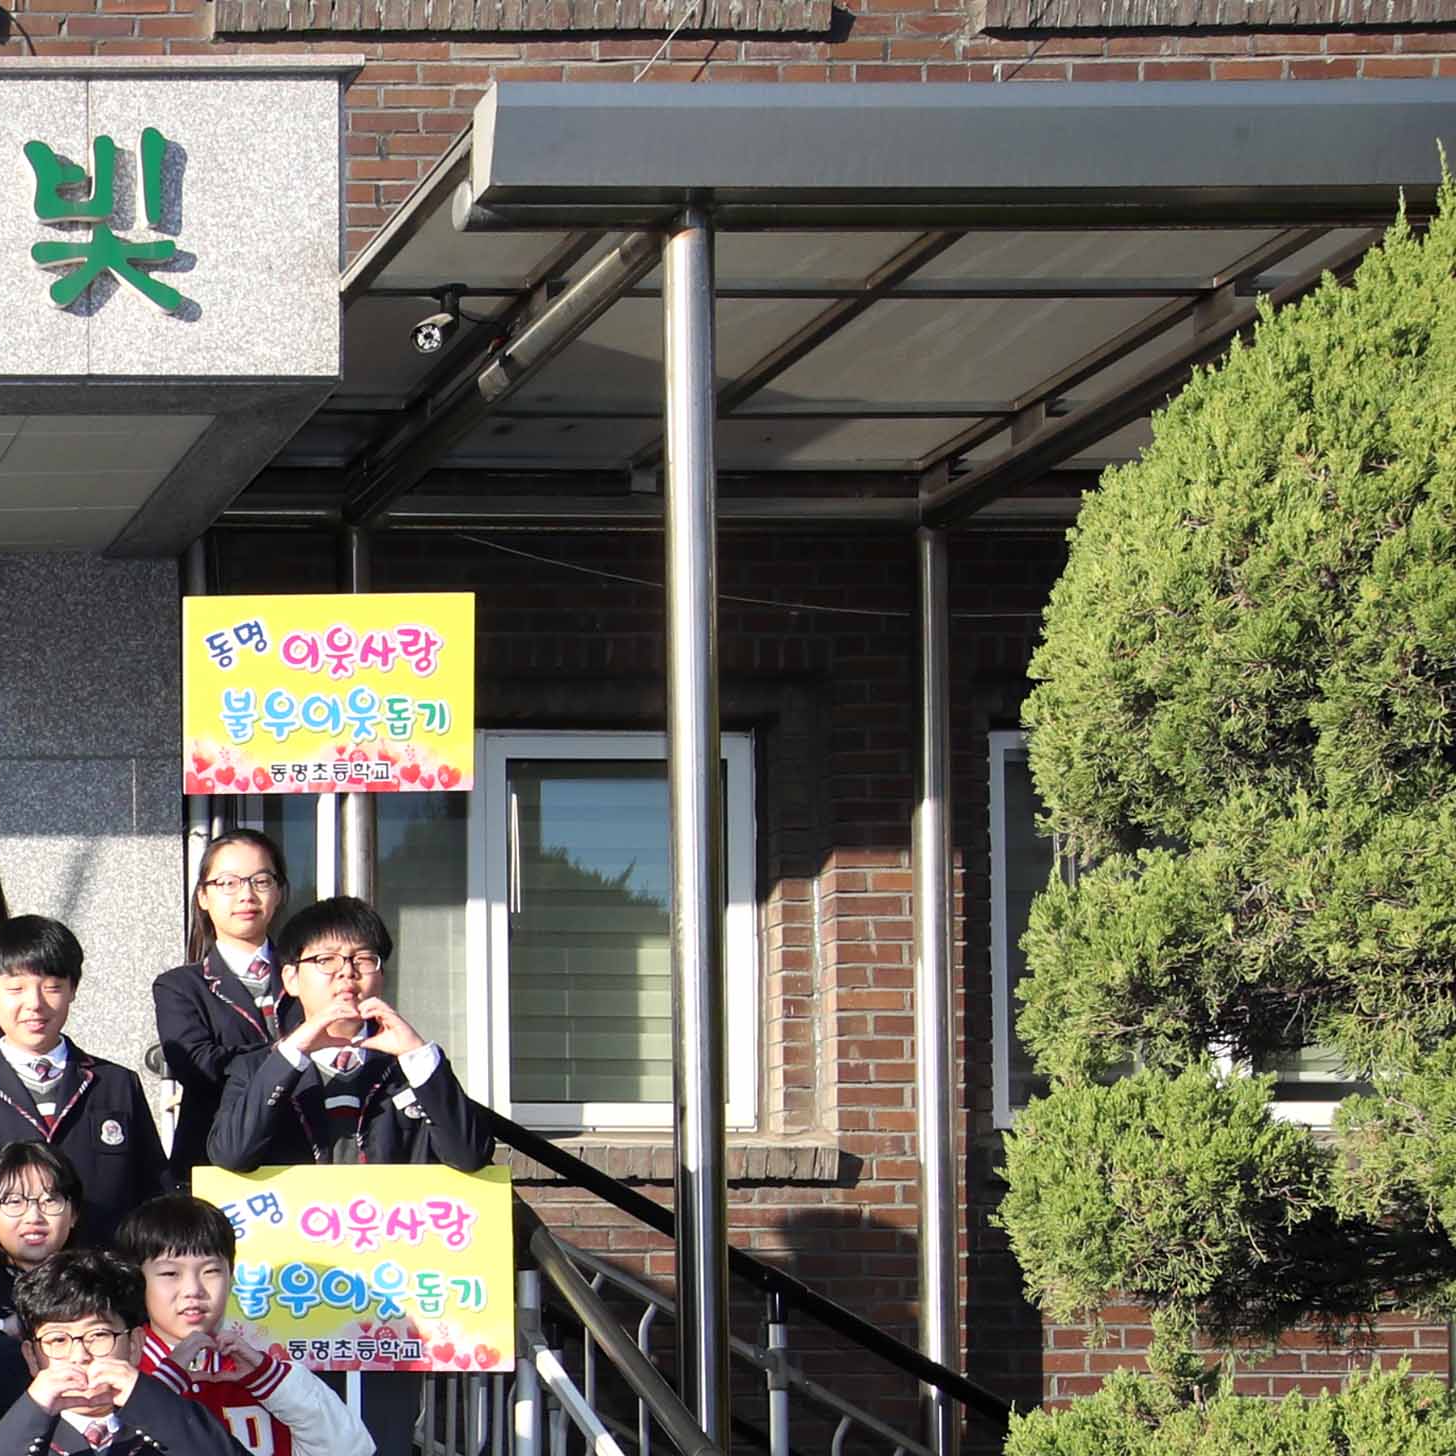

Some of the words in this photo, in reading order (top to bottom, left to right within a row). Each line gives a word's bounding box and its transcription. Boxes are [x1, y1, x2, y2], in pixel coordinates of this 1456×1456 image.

[23, 126, 182, 315] 빛
[206, 620, 267, 668] 동명
[282, 627, 440, 674] 이웃사랑
[271, 762, 390, 783] 동명초등학교
[300, 1199, 472, 1248] 이웃사랑
[288, 1339, 422, 1361] 동명초등학교
